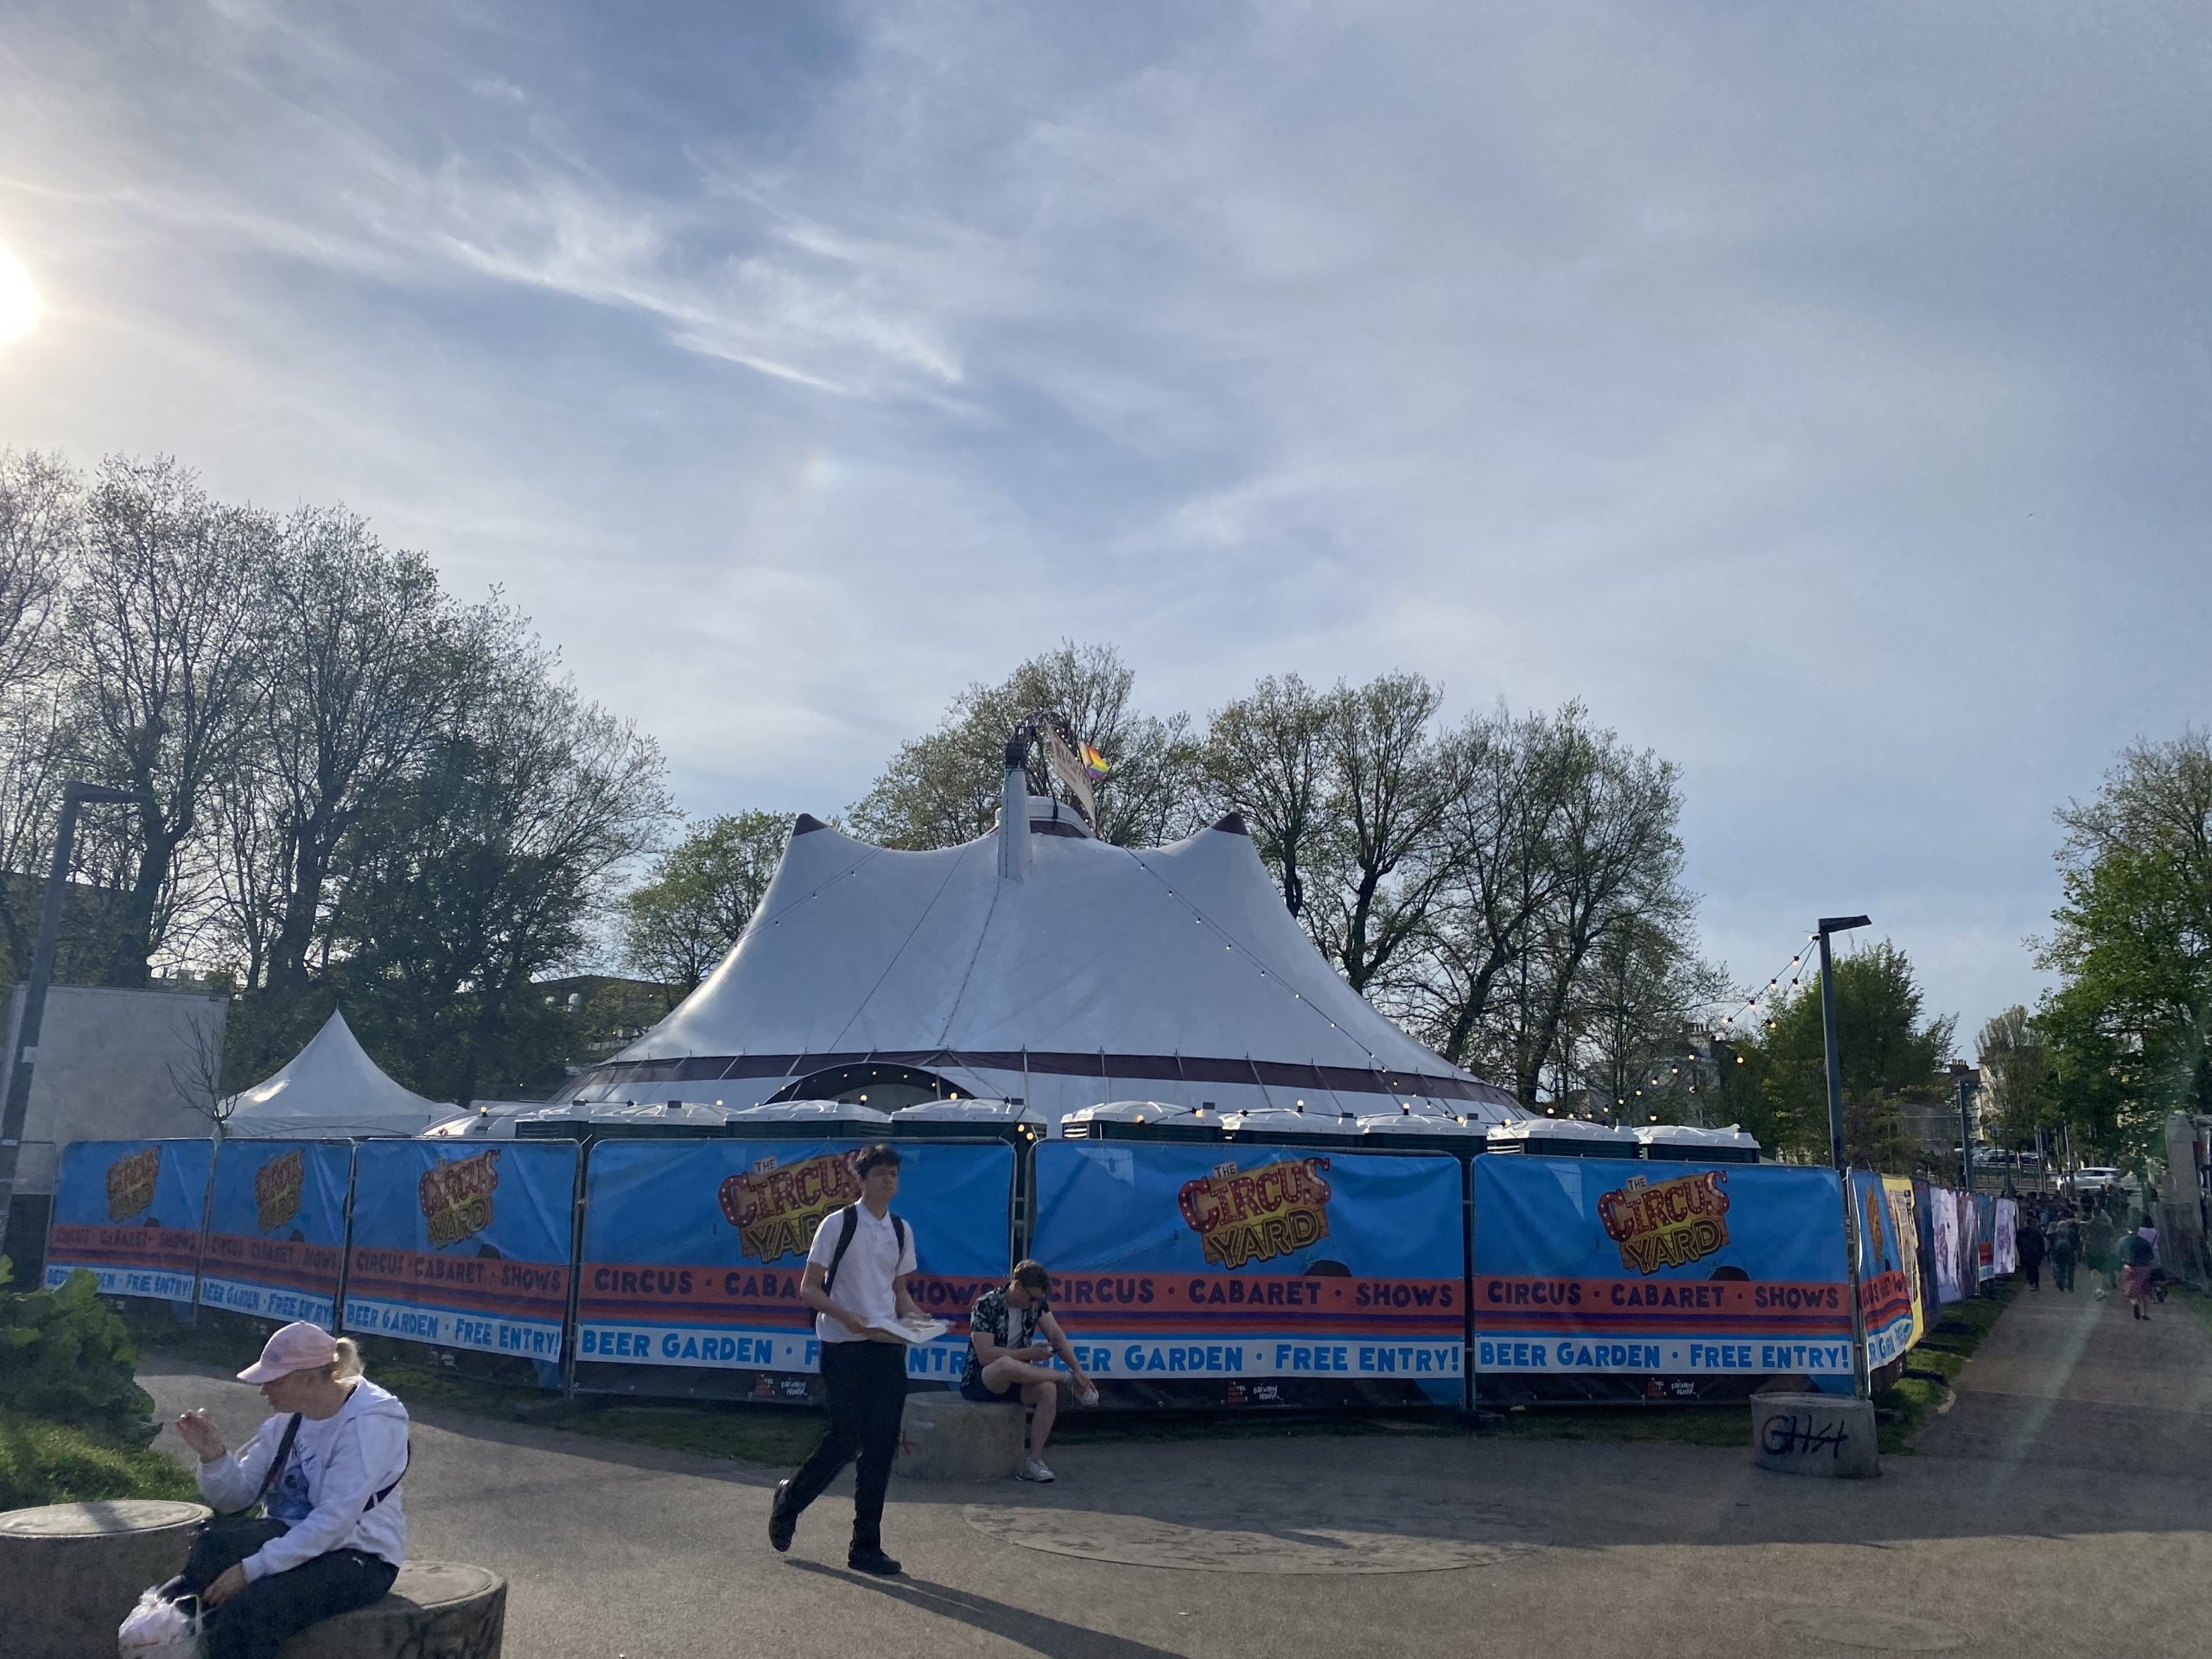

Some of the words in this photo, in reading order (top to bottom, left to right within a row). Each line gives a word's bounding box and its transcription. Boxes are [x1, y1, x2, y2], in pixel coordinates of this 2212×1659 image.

[418, 1149, 500, 1217] CIRCUS
[755, 1159, 775, 1173] THE
[1214, 1163, 1236, 1177] THE
[1628, 1177, 1646, 1189] THE
[1178, 1157, 1332, 1234] CIRCUS
[1598, 1171, 1730, 1243] CIRCUS
[430, 1198, 488, 1250] YARD
[747, 1201, 851, 1265] YAR
[1210, 1206, 1320, 1270] YARD
[1626, 1218, 1723, 1275] YARD
[154, 1275, 193, 1297] ENTRY!
[356, 1250, 404, 1274] CIRCUS
[414, 1256, 485, 1284] CABARET
[501, 1265, 562, 1292] SHOWS
[594, 1268, 692, 1295] CIRCUS
[724, 1271, 801, 1300] CABA
[202, 1281, 225, 1303] BEER
[268, 1292, 297, 1317] FREE
[906, 1280, 995, 1306] HOW
[1047, 1277, 1154, 1305] CIRCUS
[1188, 1279, 1322, 1306] CABARET
[1356, 1282, 1453, 1308] SHOWS
[1487, 1280, 1582, 1306] CIRCUS
[1610, 1283, 1725, 1308] CABARET
[1755, 1286, 1840, 1310] SHOWS
[346, 1303, 378, 1329] BEER
[382, 1307, 439, 1338] GARDEN
[455, 1318, 493, 1347] FREE
[499, 1325, 561, 1357] ENTRY!
[581, 1329, 651, 1358] BEER
[662, 1332, 773, 1365] GARDEN
[1123, 1344, 1243, 1372] GARDEN
[1274, 1344, 1348, 1371] FREE
[1358, 1345, 1459, 1373] ENTRY!
[1480, 1341, 1548, 1367] BEER
[1556, 1341, 1660, 1369] GARDEN
[1689, 1343, 1752, 1369] FREE
[1762, 1343, 1849, 1370] ENTRY!
